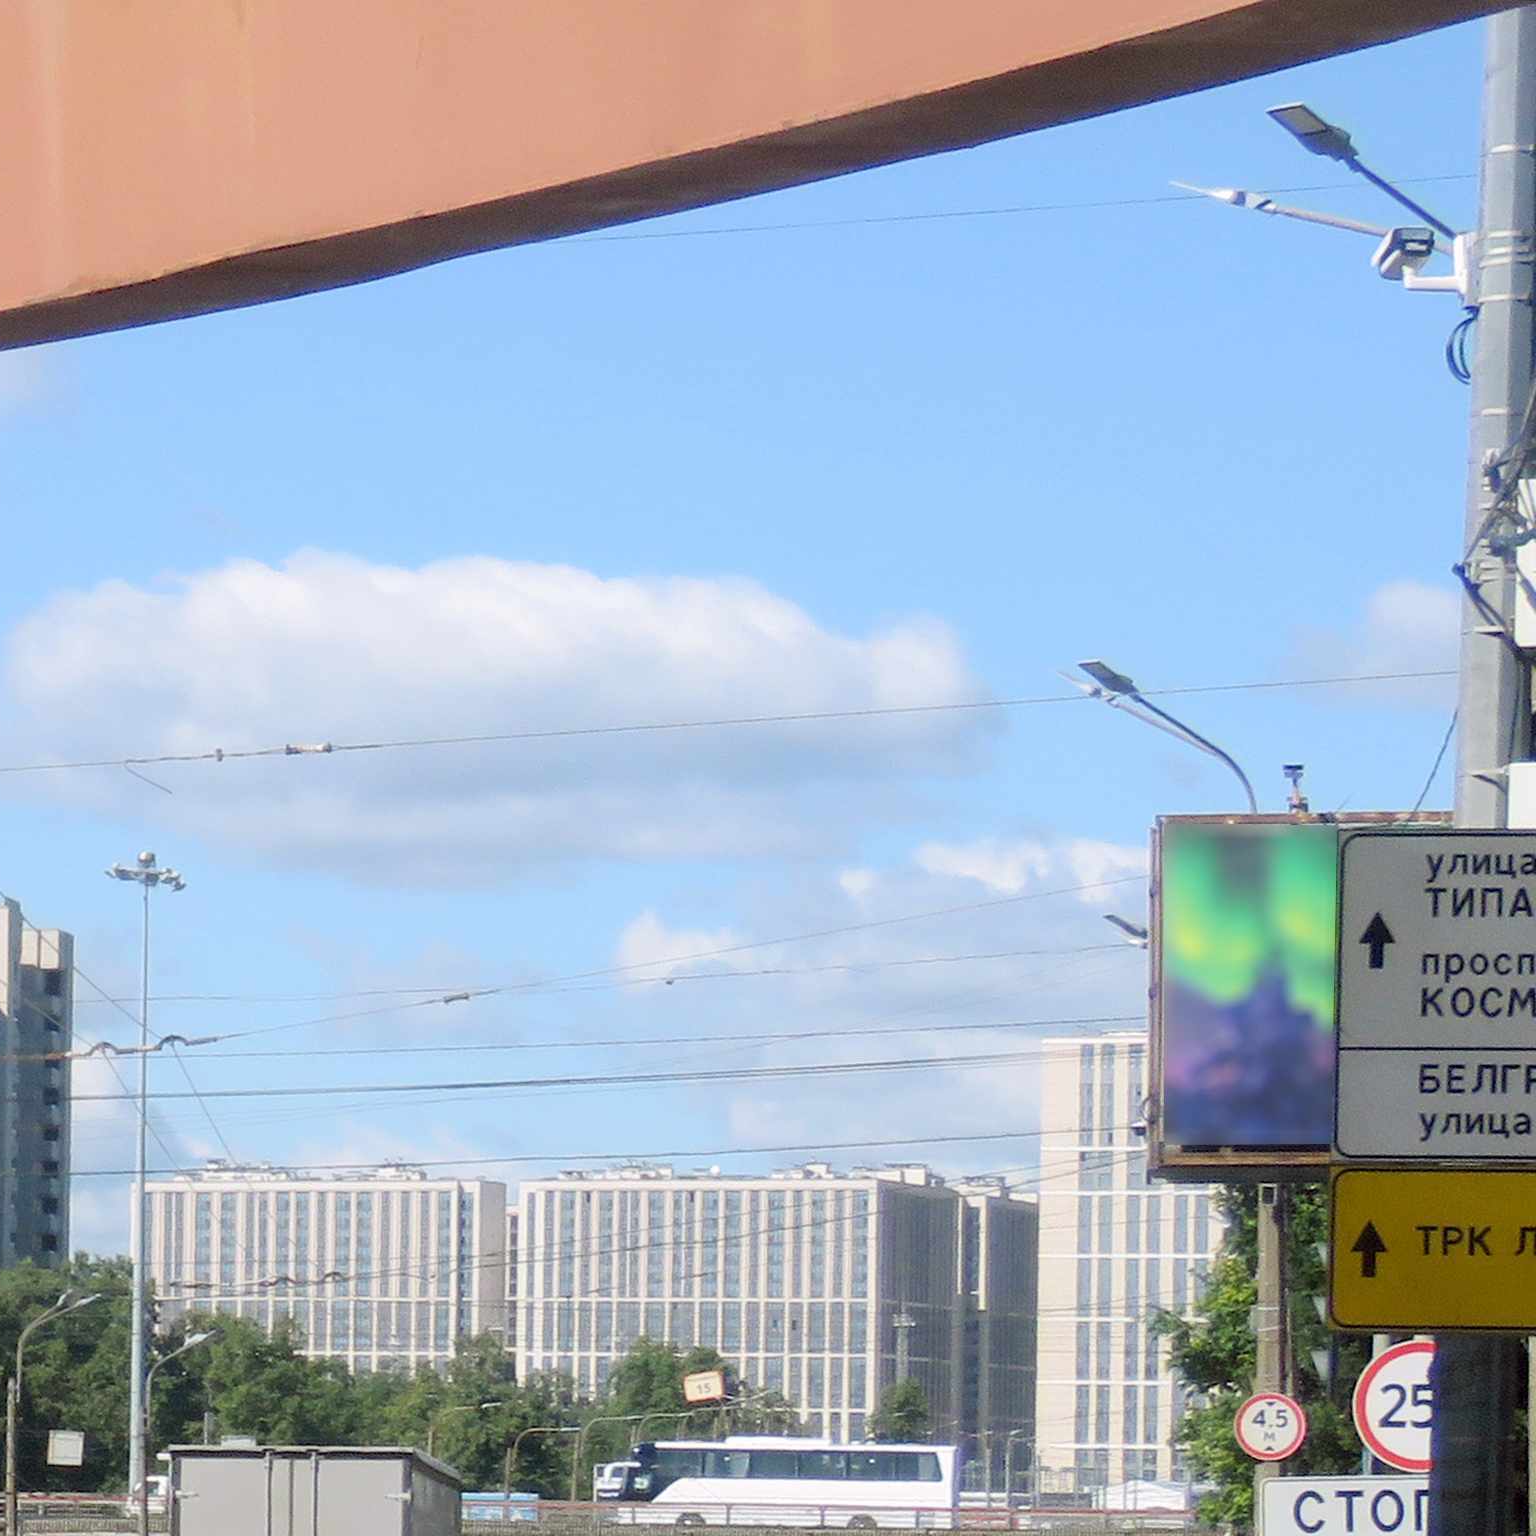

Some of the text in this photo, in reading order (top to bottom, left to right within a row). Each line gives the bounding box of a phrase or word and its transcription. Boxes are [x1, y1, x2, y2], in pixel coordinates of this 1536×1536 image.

[1426, 853, 1536, 884] улица
[1424, 887, 1534, 918] ТИПА
[1421, 953, 1536, 983] просп
[1419, 986, 1536, 1018] КОСМ
[1419, 1112, 1532, 1142] улица
[1415, 1225, 1492, 1256] ТРК
[1379, 1383, 1434, 1429] 25
